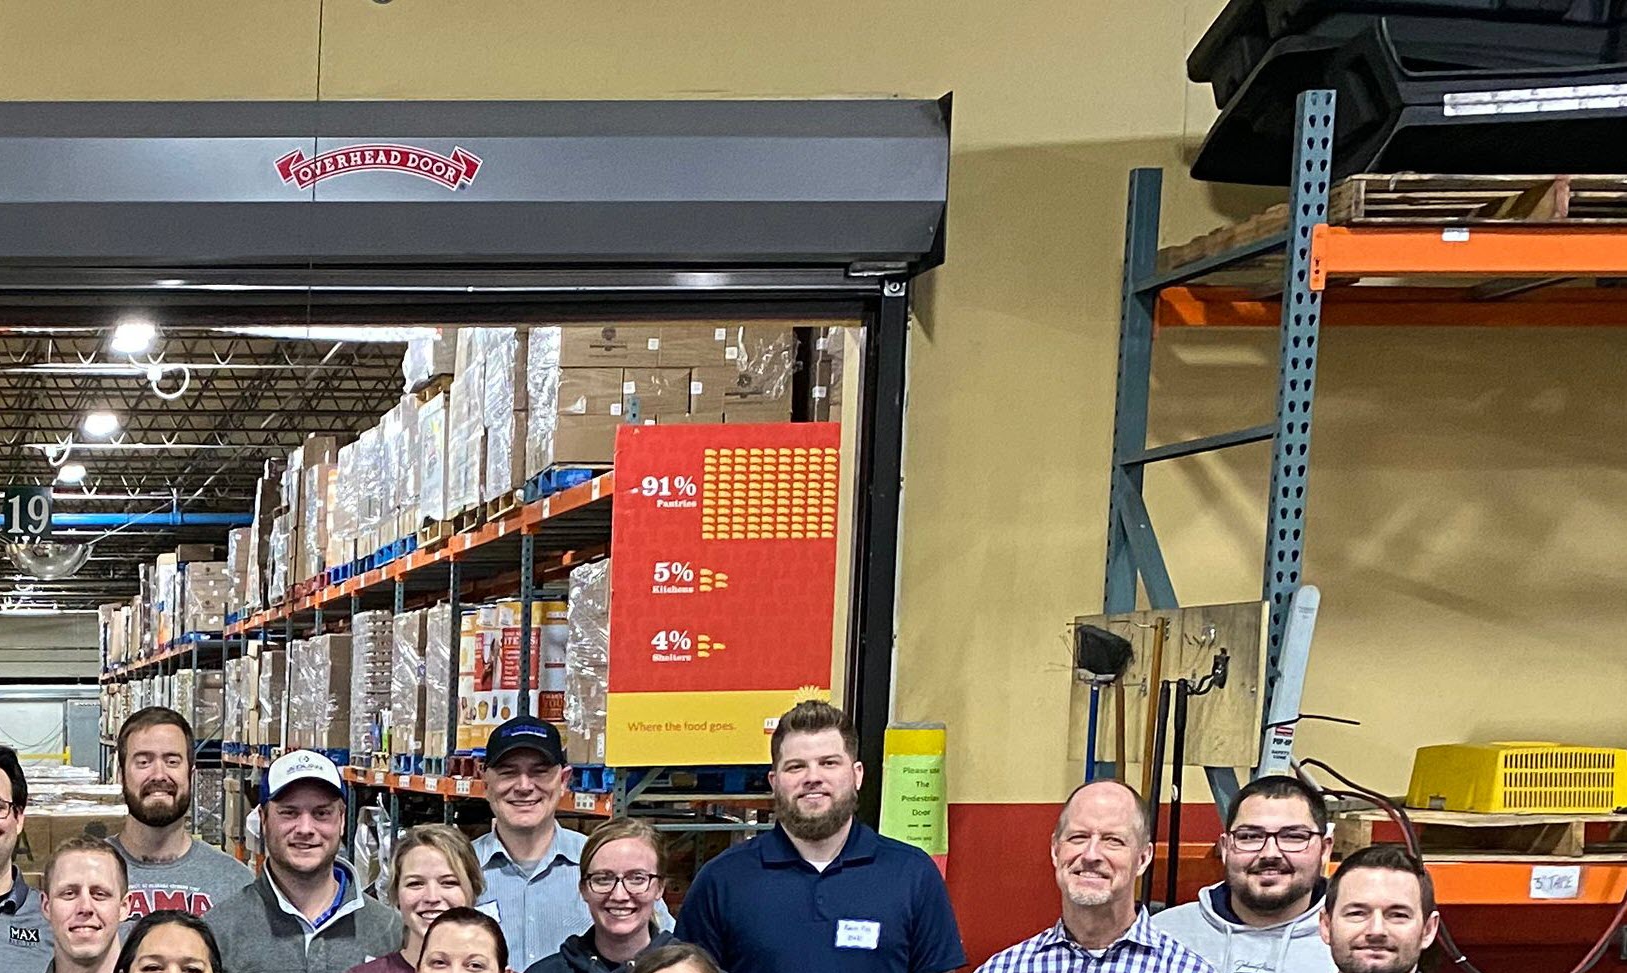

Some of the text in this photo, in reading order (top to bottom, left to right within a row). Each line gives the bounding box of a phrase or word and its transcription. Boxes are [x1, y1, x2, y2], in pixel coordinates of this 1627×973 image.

[298, 150, 456, 182] OVERHEAD DOOR
[657, 499, 697, 508] Pantries
[7, 495, 50, 534] 19
[653, 562, 694, 583] 5%
[651, 585, 694, 594] Kitchens
[651, 630, 691, 650] 4%
[652, 653, 691, 662] Shelters
[627, 721, 736, 733] Where the food goes.
[903, 766, 929, 774] Please
[10, 927, 38, 941] MAX
